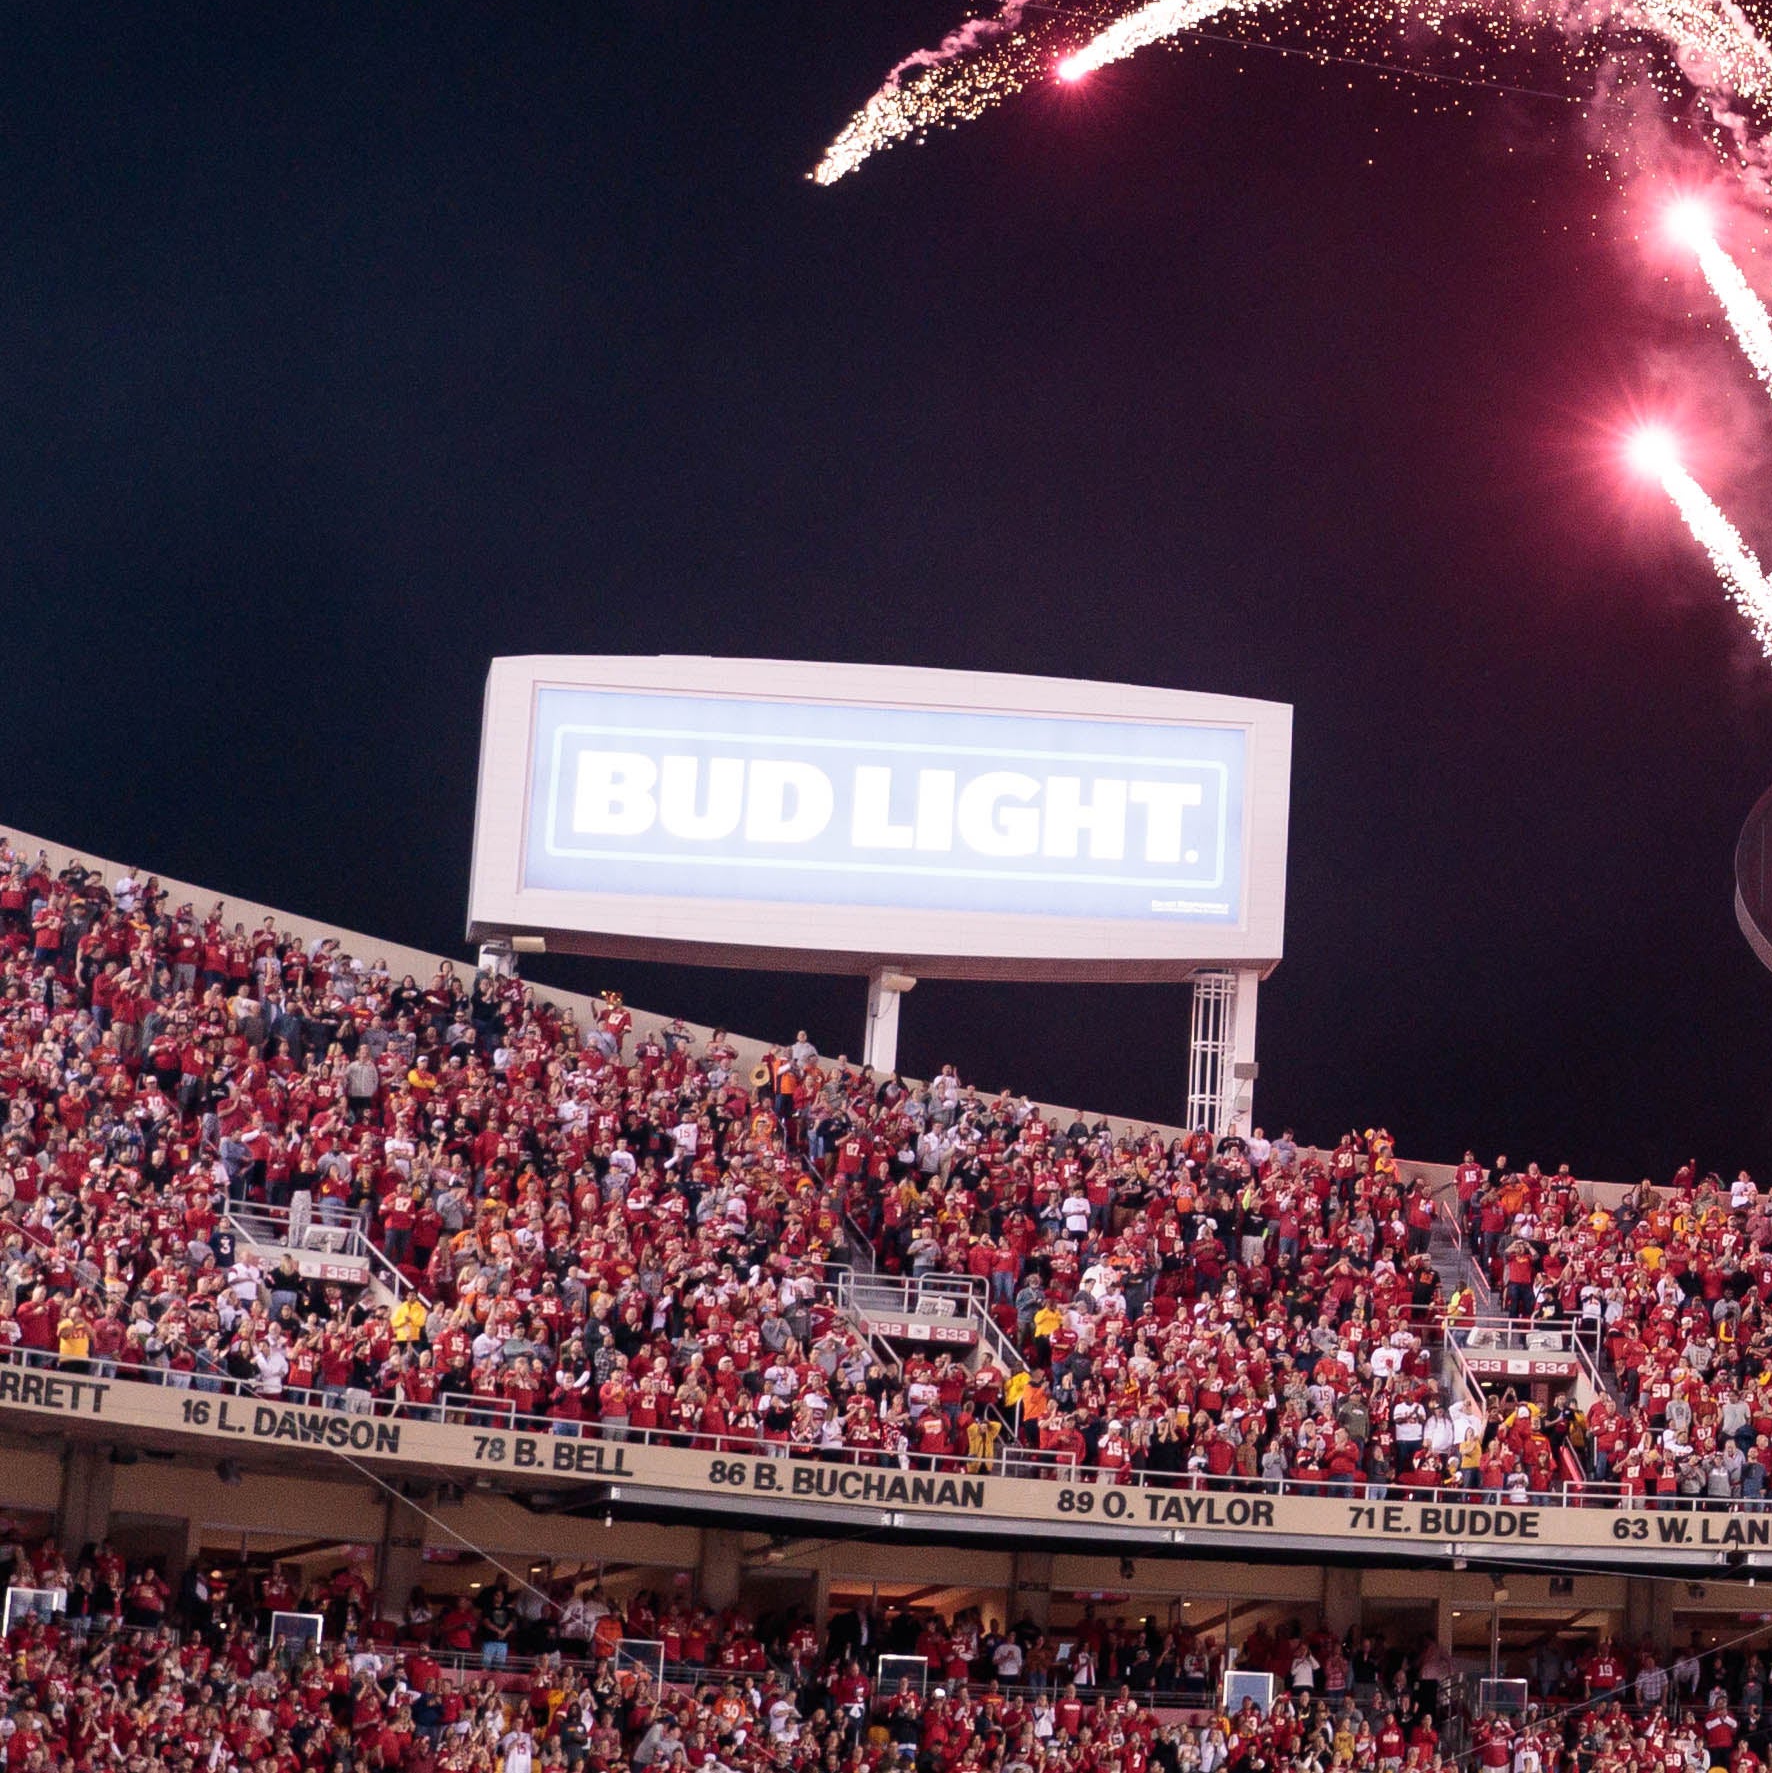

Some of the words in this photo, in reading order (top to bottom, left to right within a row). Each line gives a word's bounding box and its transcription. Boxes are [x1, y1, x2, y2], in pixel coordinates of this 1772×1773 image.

[572, 748, 834, 842] BUD
[326, 1266, 361, 1282] 332
[935, 1328, 970, 1342] 333
[1468, 1359, 1502, 1372] 333
[1535, 1361, 1569, 1375] 334
[183, 1399, 211, 1425] 16
[218, 1401, 246, 1433] L.
[253, 1406, 401, 1452] DAWSON
[474, 1436, 505, 1462] 78
[514, 1438, 545, 1468] B.
[553, 1441, 634, 1478] BELL
[709, 1460, 746, 1485] 86
[754, 1463, 783, 1491] B.
[792, 1466, 985, 1509] BUCHANAN
[1057, 1490, 1094, 1513] 89
[1103, 1491, 1134, 1518] O.
[1144, 1494, 1274, 1526] TAYLOR
[1349, 1507, 1375, 1529] 71
[1383, 1506, 1411, 1532] E.
[1420, 1508, 1540, 1538] BUDDE
[1613, 1518, 1648, 1539] 63
[1657, 1517, 1692, 1543] W.
